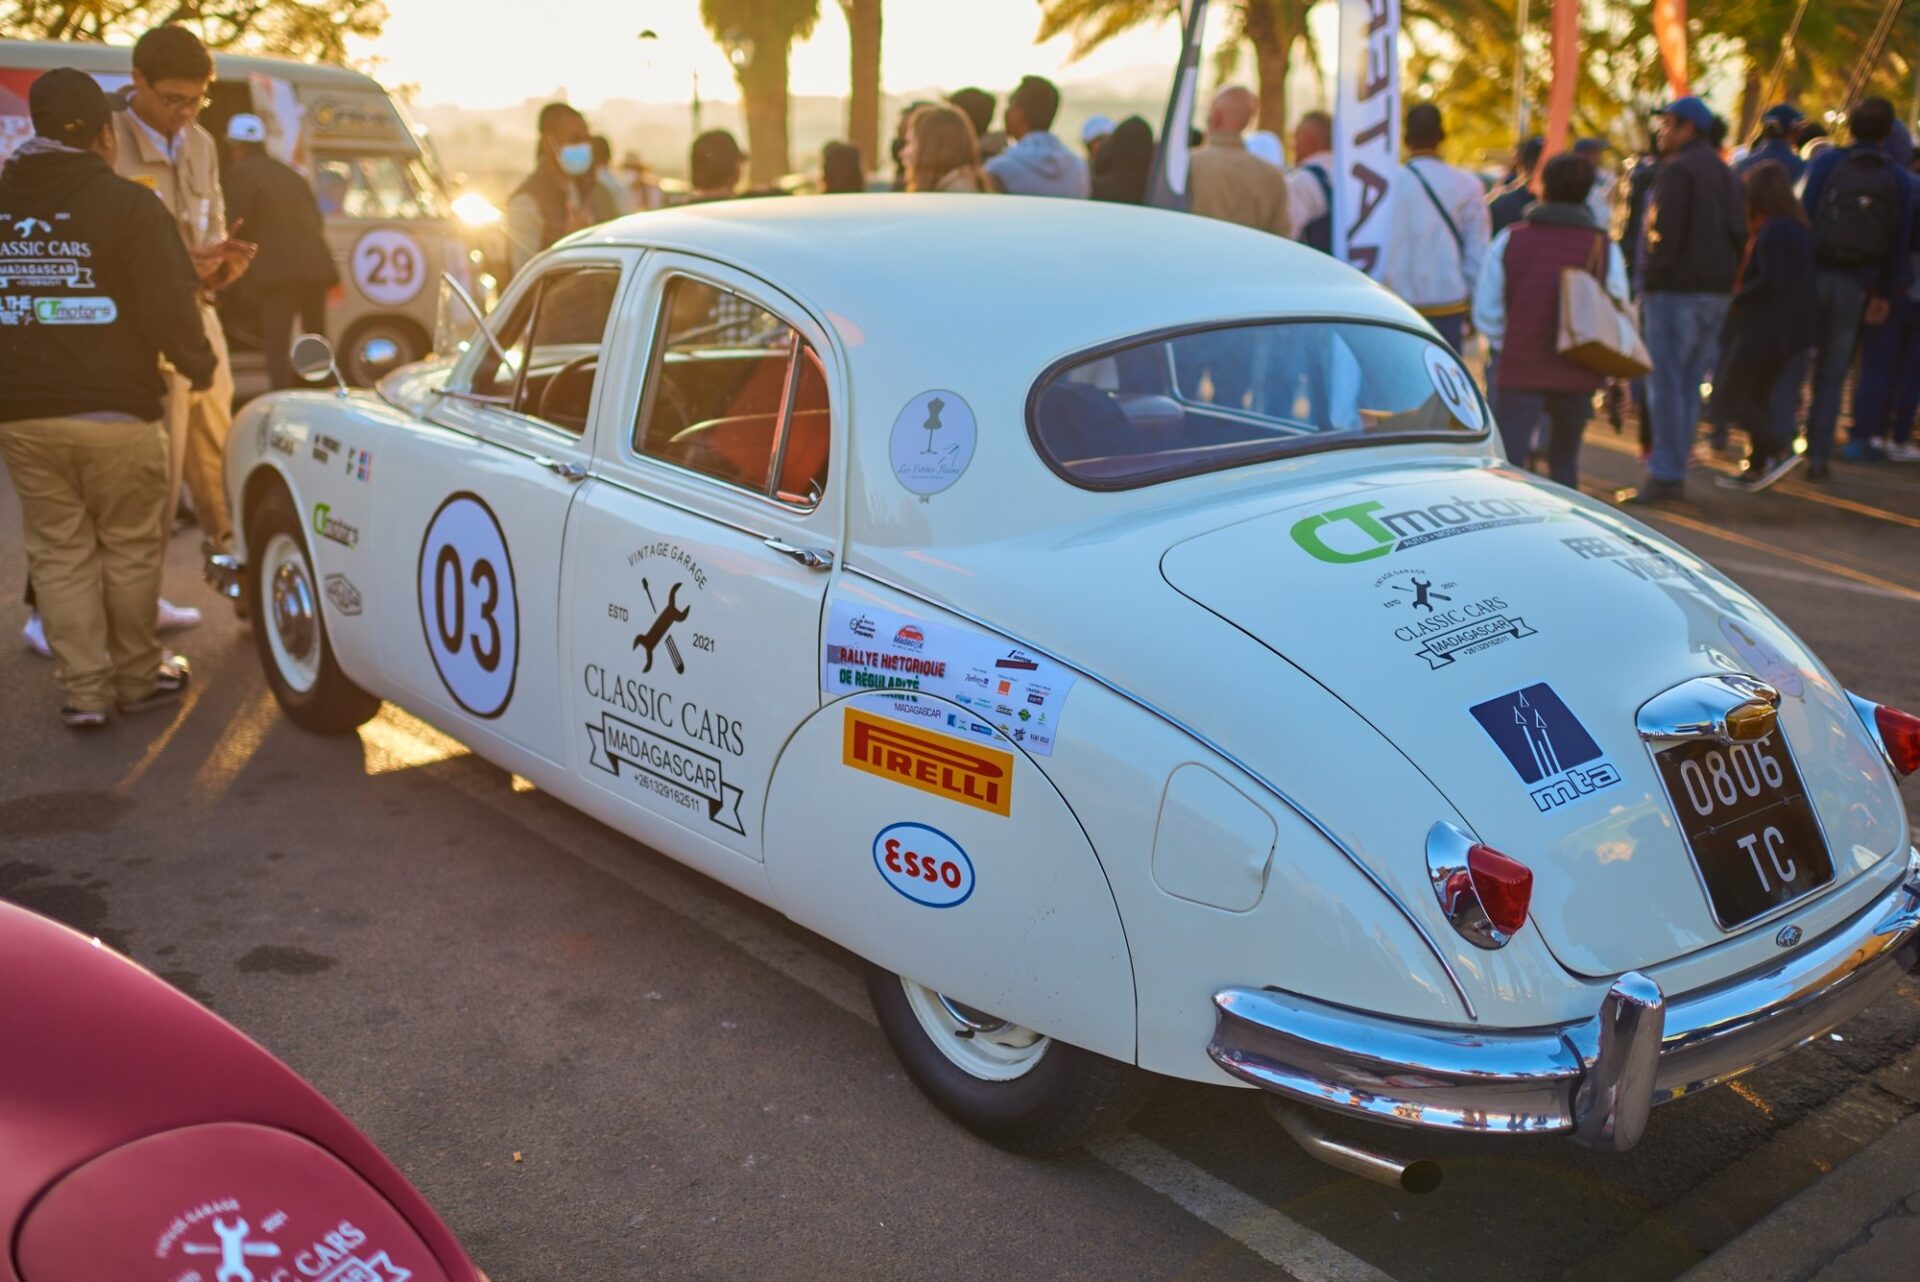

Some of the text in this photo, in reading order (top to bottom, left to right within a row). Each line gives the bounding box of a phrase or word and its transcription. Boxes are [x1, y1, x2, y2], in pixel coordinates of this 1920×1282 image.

[0, 241, 91, 257] ASSIC CARS
[366, 247, 414, 285] 29
[1404, 536, 1429, 548] AUTO
[627, 543, 708, 590] VINTAGE GARAGE
[436, 544, 502, 673] 03
[608, 603, 629, 622] ESTD
[1394, 596, 1509, 642] CLASSIC CARS
[692, 633, 715, 653] 2021
[1430, 619, 1512, 653] MADAGASCAR
[839, 647, 947, 678] RALLYE HISTORIQUE
[839, 669, 852, 685] DE
[584, 664, 744, 757] CLASSIC CARS
[894, 703, 942, 718] MADAGASCAR
[608, 726, 718, 794] MADAGASCAR
[853, 720, 1003, 805] PIRELLI
[1681, 738, 1784, 816] 0806
[1530, 763, 1622, 812] mta
[885, 839, 961, 888] ESSO
[1737, 826, 1797, 892] TC
[295, 1220, 367, 1276] CARS
